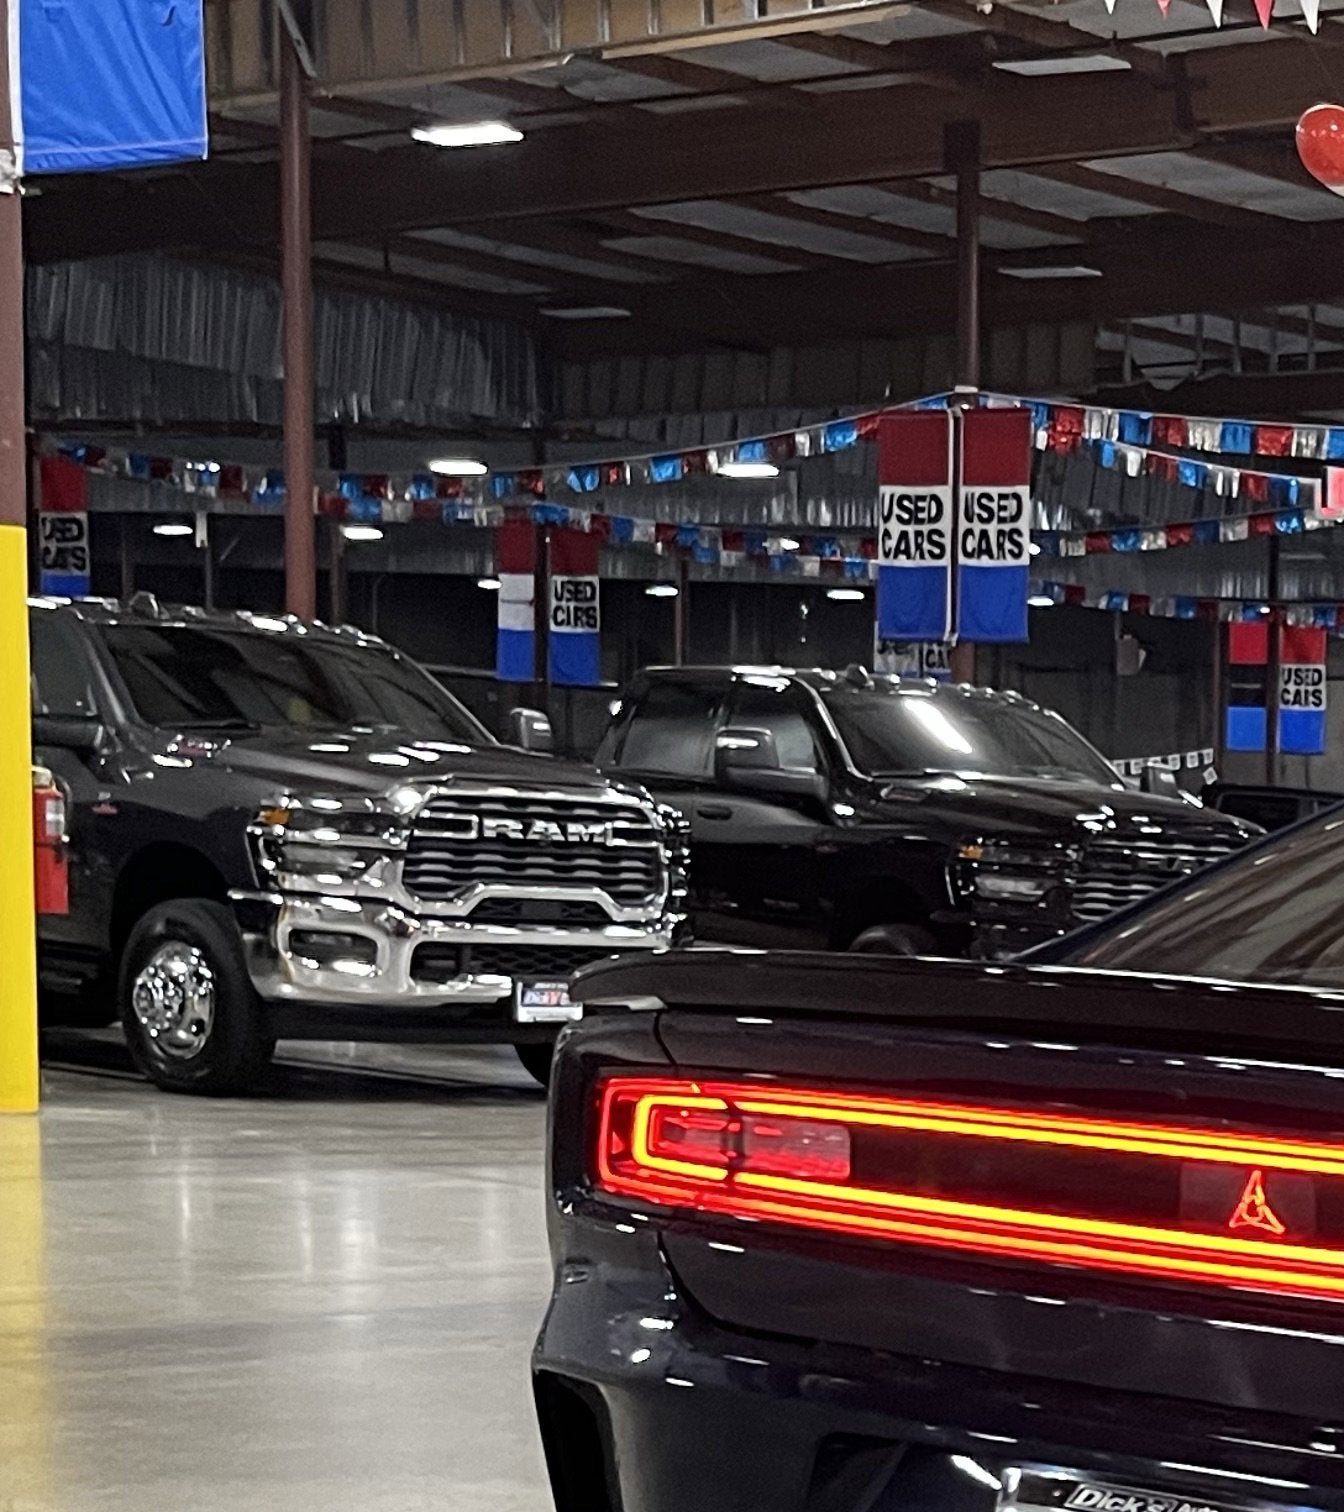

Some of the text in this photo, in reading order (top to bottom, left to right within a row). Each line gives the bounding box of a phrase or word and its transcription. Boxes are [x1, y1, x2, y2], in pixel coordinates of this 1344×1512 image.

[881, 493, 944, 525] USED
[964, 492, 1023, 524] USED
[881, 528, 946, 560] CARS
[961, 528, 1024, 560] CARS
[555, 580, 597, 602] USED
[483, 818, 607, 843] RAM
